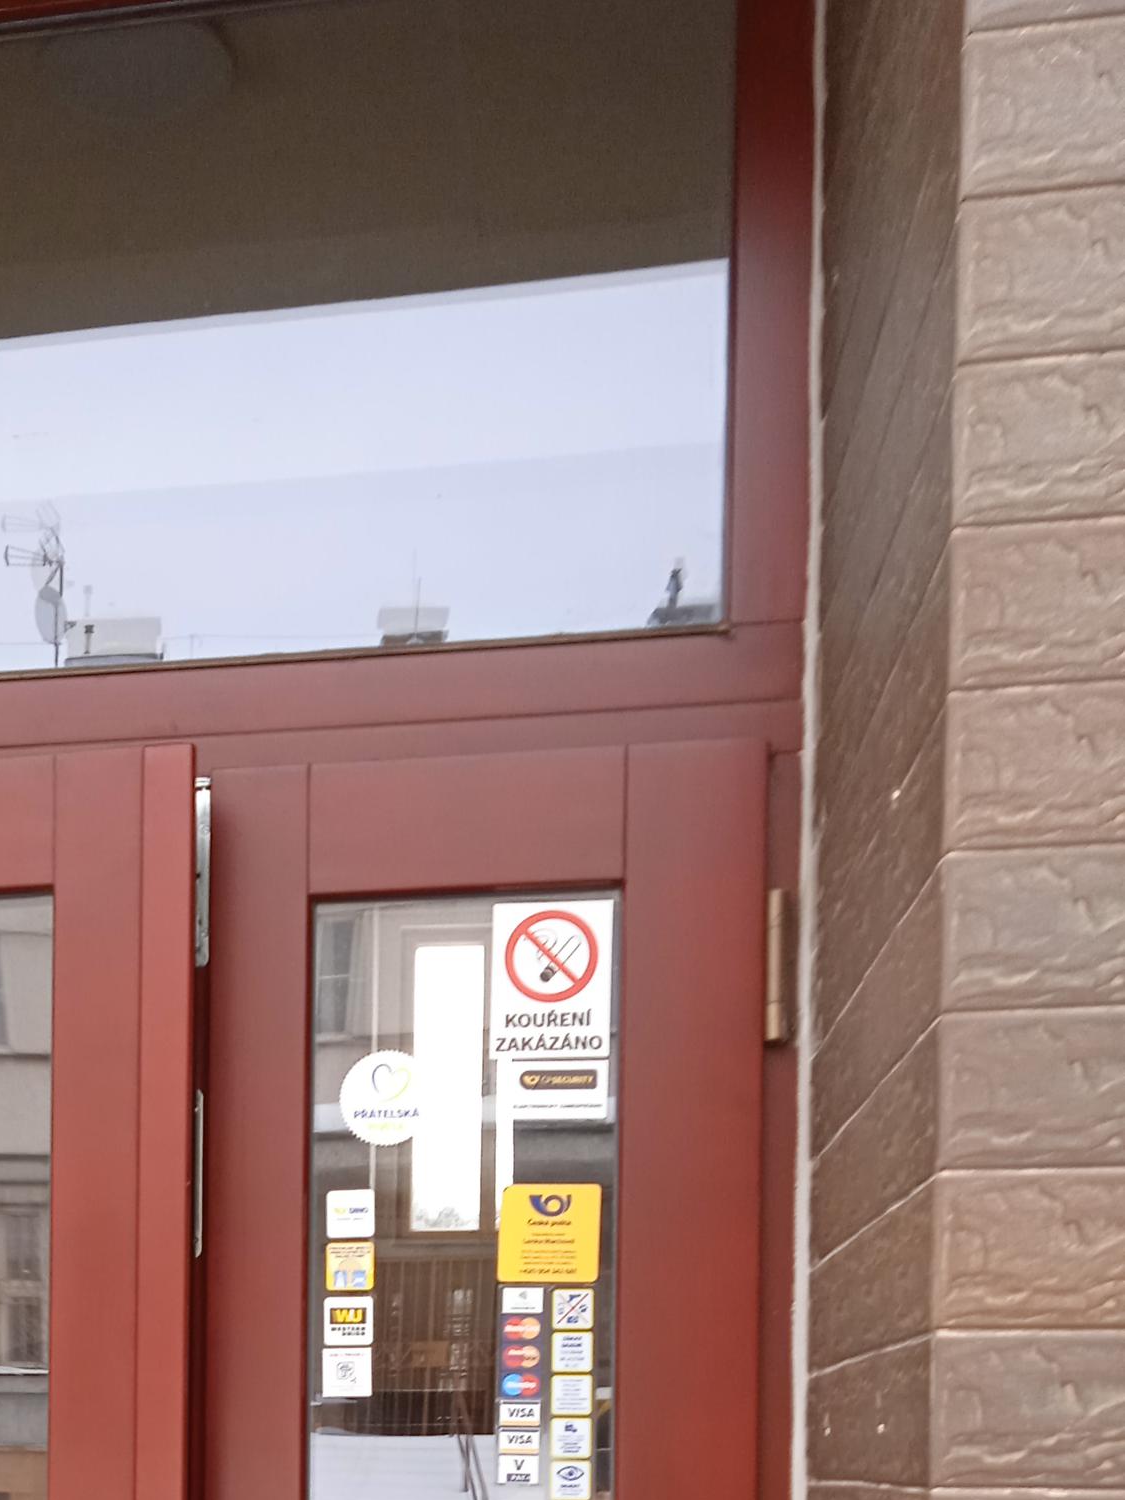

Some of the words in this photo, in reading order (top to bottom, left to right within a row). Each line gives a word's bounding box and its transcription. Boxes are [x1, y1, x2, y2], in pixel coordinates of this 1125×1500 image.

[505, 1008, 592, 1028] KOUŘENÍ
[495, 1033, 603, 1052] ZAKÁZÁNO
[508, 1407, 535, 1418] VISA
[508, 1434, 533, 1445] VISA
